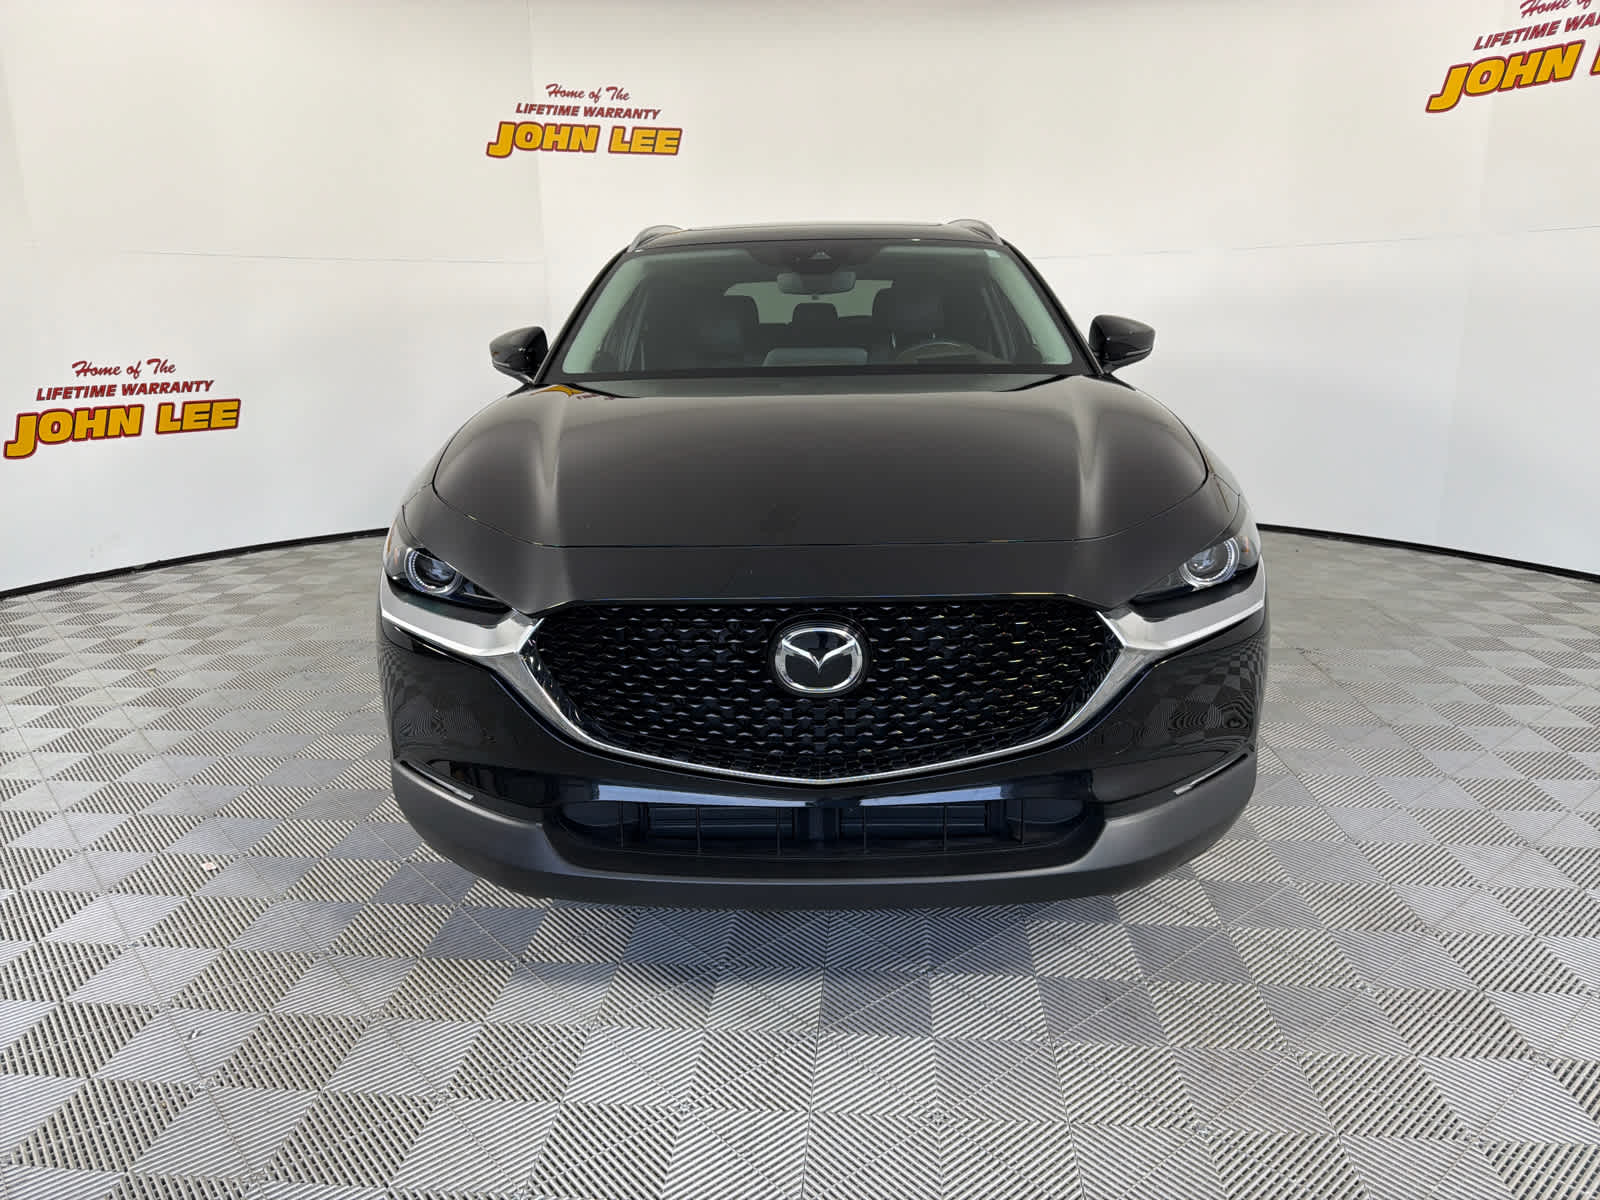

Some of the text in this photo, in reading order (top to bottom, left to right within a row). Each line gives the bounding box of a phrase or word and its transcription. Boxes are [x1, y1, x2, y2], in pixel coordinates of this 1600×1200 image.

[1520, 0, 1571, 18] Home
[1473, 20, 1561, 50] LIFETIME
[1425, 40, 1585, 113] JOHN
[545, 83, 630, 103] Home of The
[515, 103, 660, 120] LIFETIME WARRANTY
[486, 121, 682, 158] JOHN LEE
[72, 358, 176, 379] Home of The
[36, 380, 214, 400] LIFETIME WARRANTY
[3, 398, 241, 459] JOHN LEE
